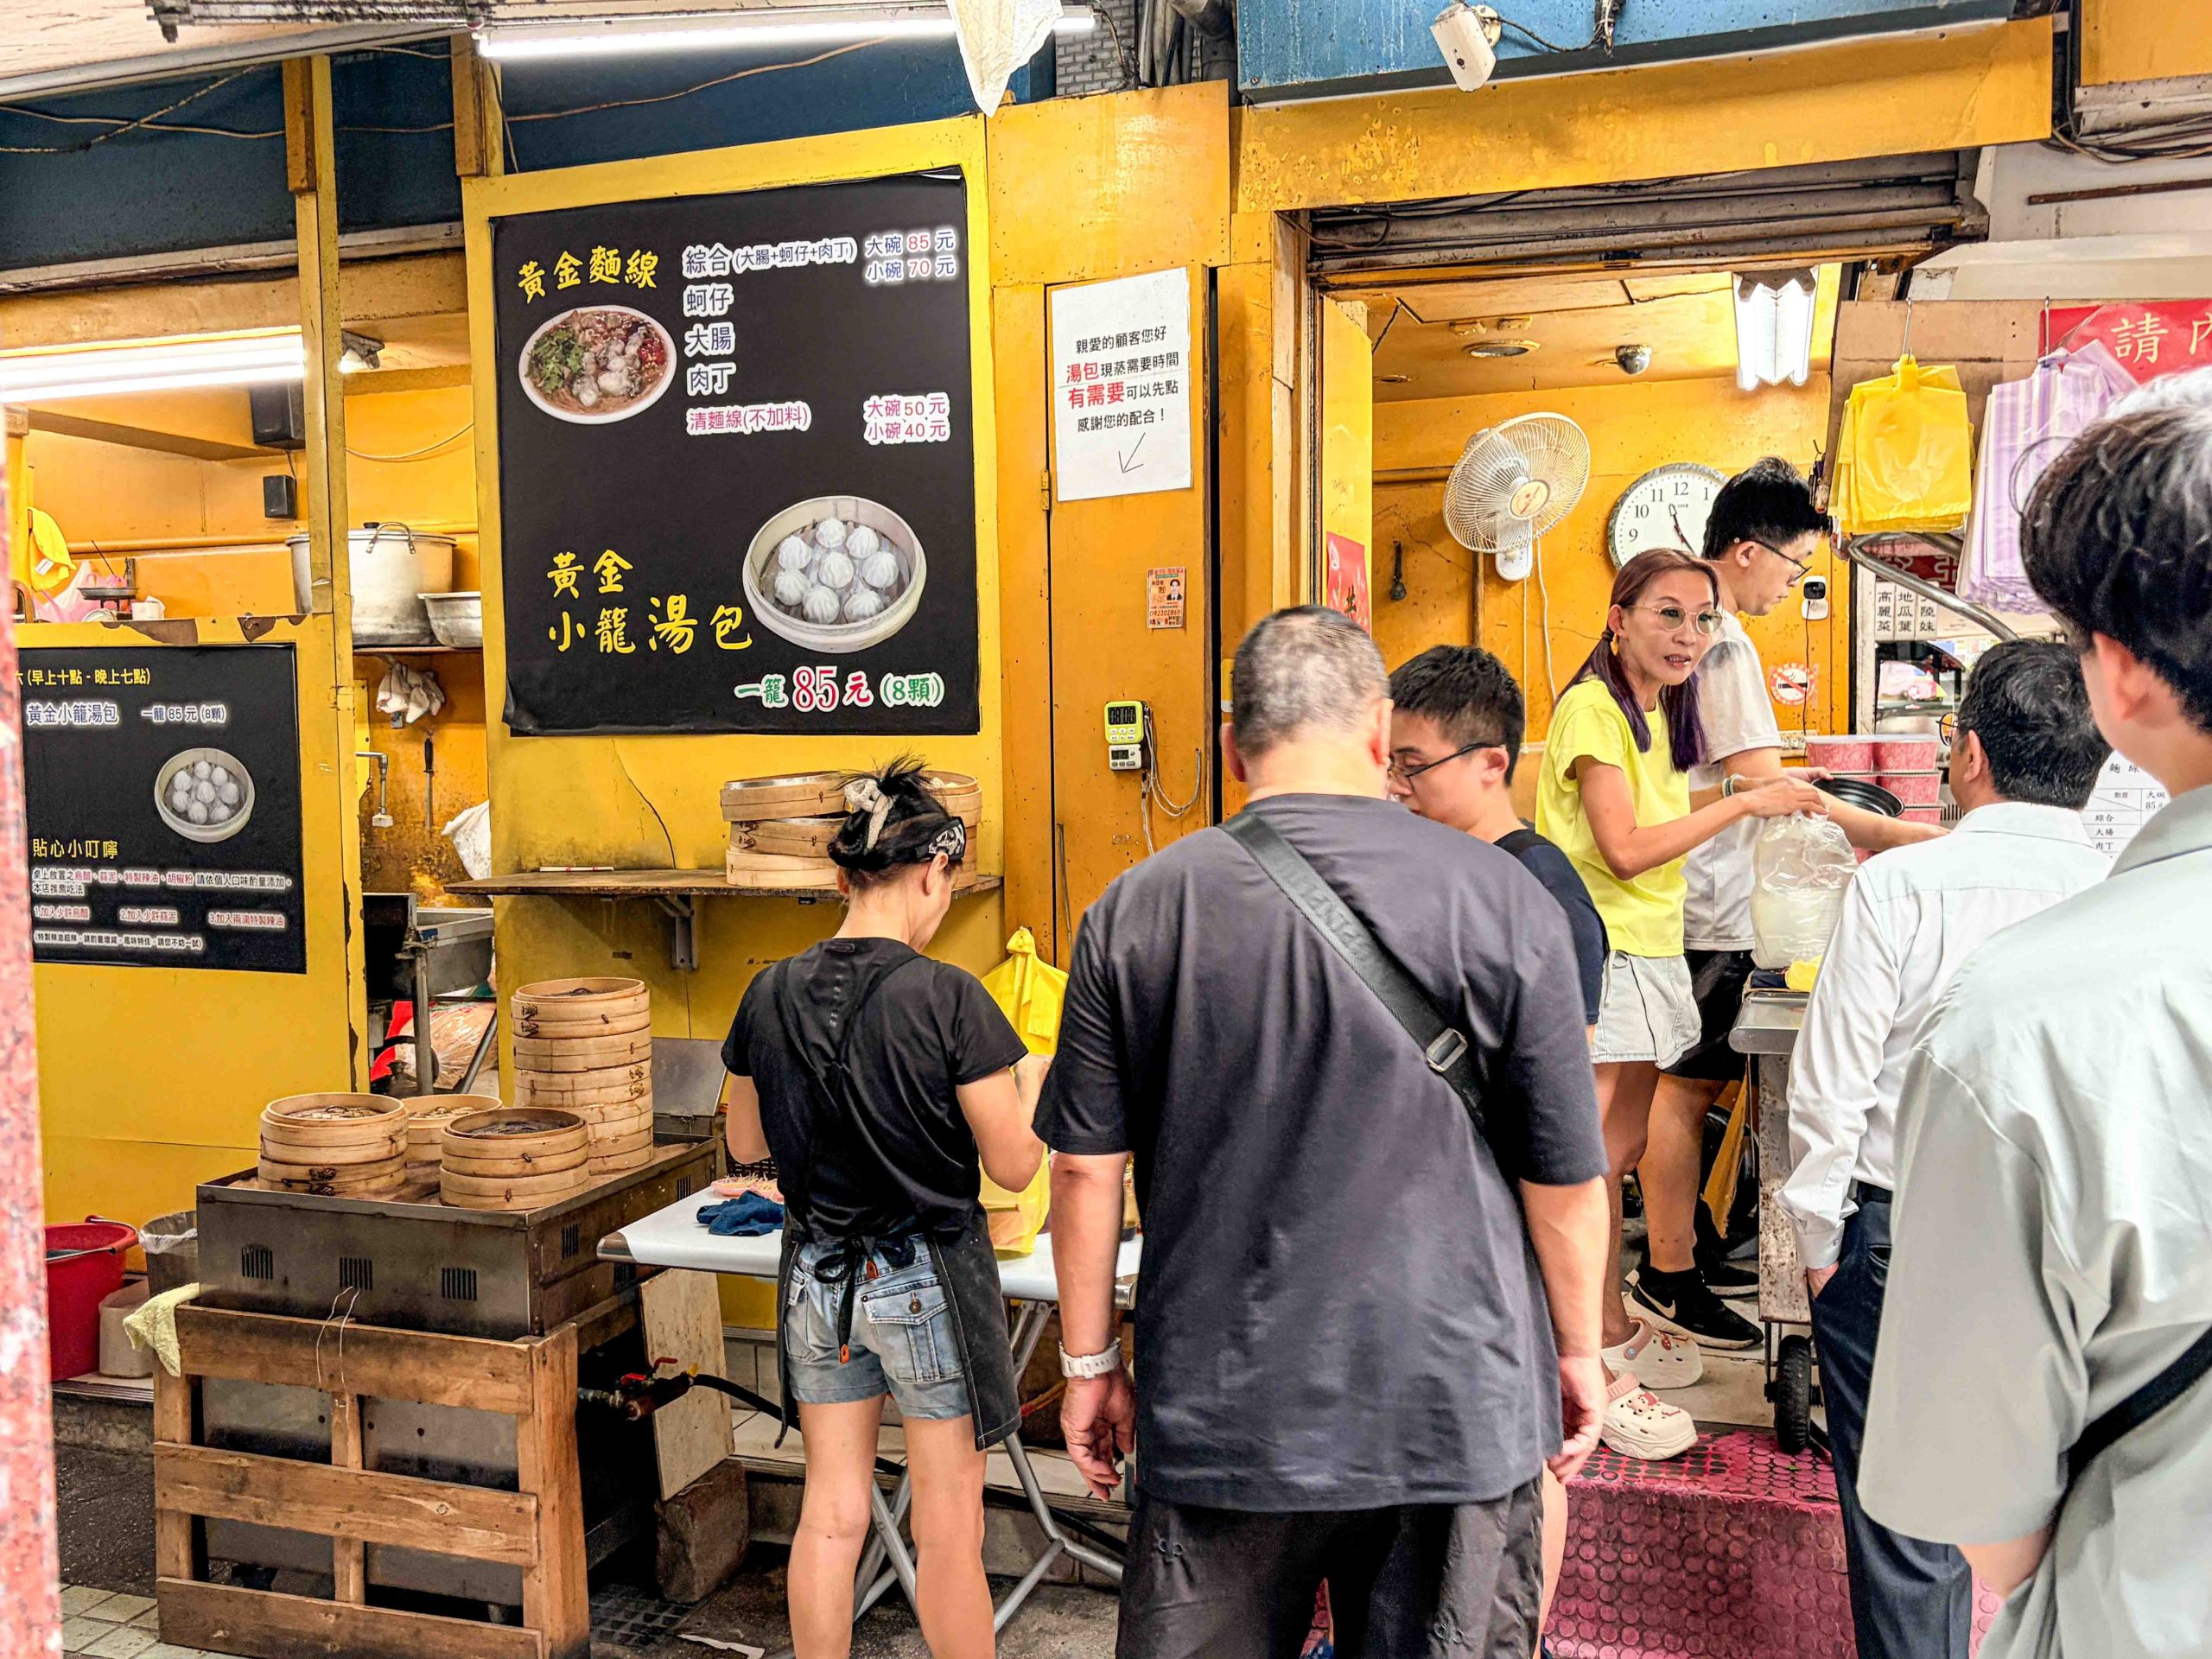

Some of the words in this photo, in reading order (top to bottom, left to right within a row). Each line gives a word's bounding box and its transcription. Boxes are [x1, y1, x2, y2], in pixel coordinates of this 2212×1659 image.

[683, 245, 731, 274] 綜合
[734, 240, 855, 273] (大腸+蚵仔+肉丁)
[864, 236, 904, 257] 大碗
[907, 234, 931, 251] 85
[935, 231, 957, 251] 元
[518, 245, 659, 304] 黃金麵線
[865, 259, 904, 281] 小碗
[908, 259, 931, 276] 70
[935, 257, 957, 276] 元
[685, 287, 732, 315] 蚵仔
[687, 327, 733, 354] 大腸
[1076, 326, 1166, 354] 親愛的顧客您好
[689, 366, 733, 393] 肉丁
[1066, 352, 1179, 384] 湯包現蒸需要時間
[1068, 379, 1179, 410] 有需要可以先點
[688, 405, 810, 432] 清麵線(不加料)
[866, 399, 901, 419] 大碗
[904, 402, 925, 416] 50
[928, 397, 947, 416] 元
[866, 422, 901, 442] 小碗
[904, 423, 925, 439] 40
[929, 419, 947, 437] 元
[1651, 489, 1664, 502] 11
[1674, 481, 1689, 496] 12
[1703, 486, 1710, 500] 1
[1635, 504, 1649, 518] 10
[1629, 528, 1638, 542] 9
[546, 550, 634, 600] 黃金
[548, 595, 753, 654] 小籠湯包
[1877, 591, 1892, 632] 高麗菜
[738, 677, 786, 706] 一籠
[792, 666, 837, 711] 85
[843, 674, 871, 704] 元
[882, 675, 944, 707] (8顆)
[28, 702, 118, 725] 黃金小籠湯包
[168, 707, 181, 720] 85
[185, 706, 197, 721] 元
[32, 837, 118, 860] 貼心小叮嚀
[2095, 842, 2114, 850] 肉丁
